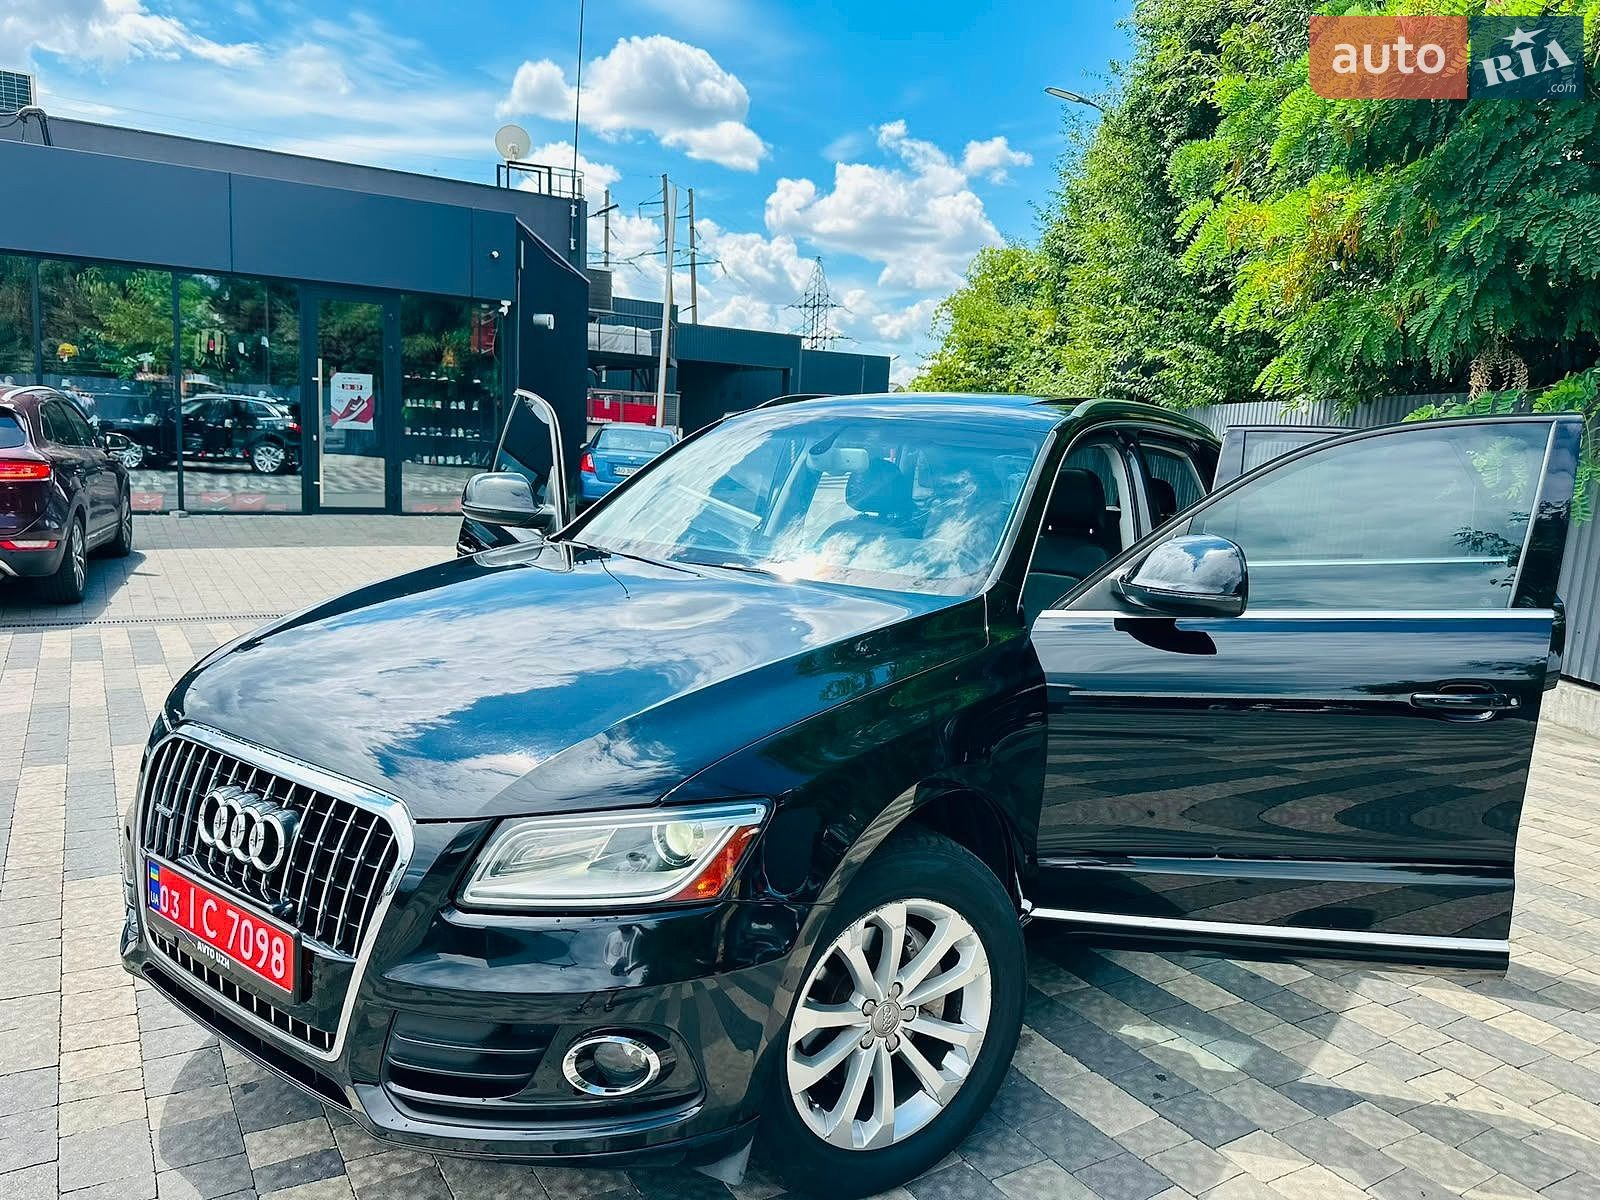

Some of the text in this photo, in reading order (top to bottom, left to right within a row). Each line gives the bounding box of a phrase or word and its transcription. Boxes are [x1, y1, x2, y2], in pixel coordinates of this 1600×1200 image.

[150, 890, 159, 906] UA
[160, 885, 180, 920] 03
[225, 909, 285, 979] 7098
[197, 940, 230, 970] AVTO UZH
